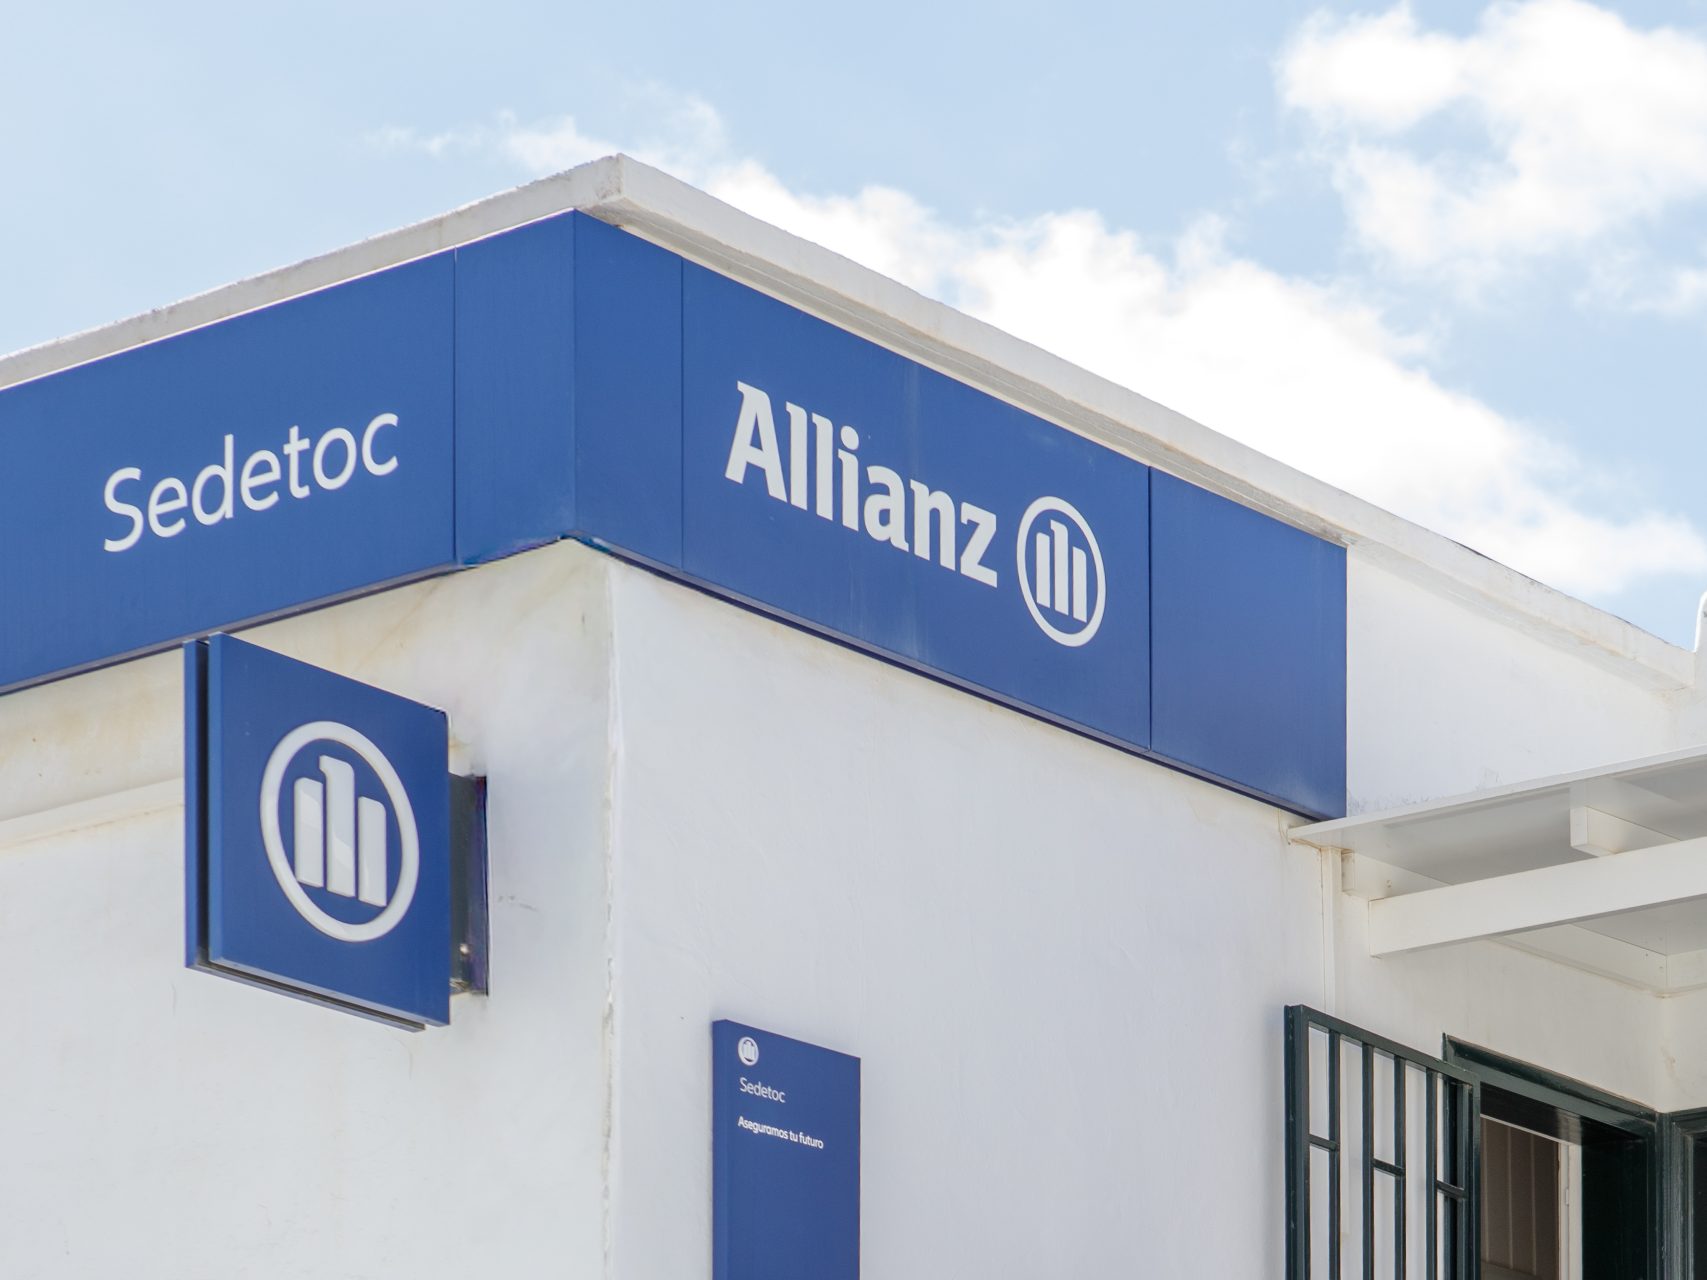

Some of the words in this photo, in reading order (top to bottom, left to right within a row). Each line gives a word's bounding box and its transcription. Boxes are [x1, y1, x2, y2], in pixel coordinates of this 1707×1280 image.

[103, 412, 399, 553] Sedetoc
[724, 380, 998, 588] Allianz
[737, 1115, 789, 1140] Aseguramos
[789, 1130, 799, 1143] tu
[798, 1132, 824, 1149] futuro
[739, 1077, 786, 1103] Sedetoc
